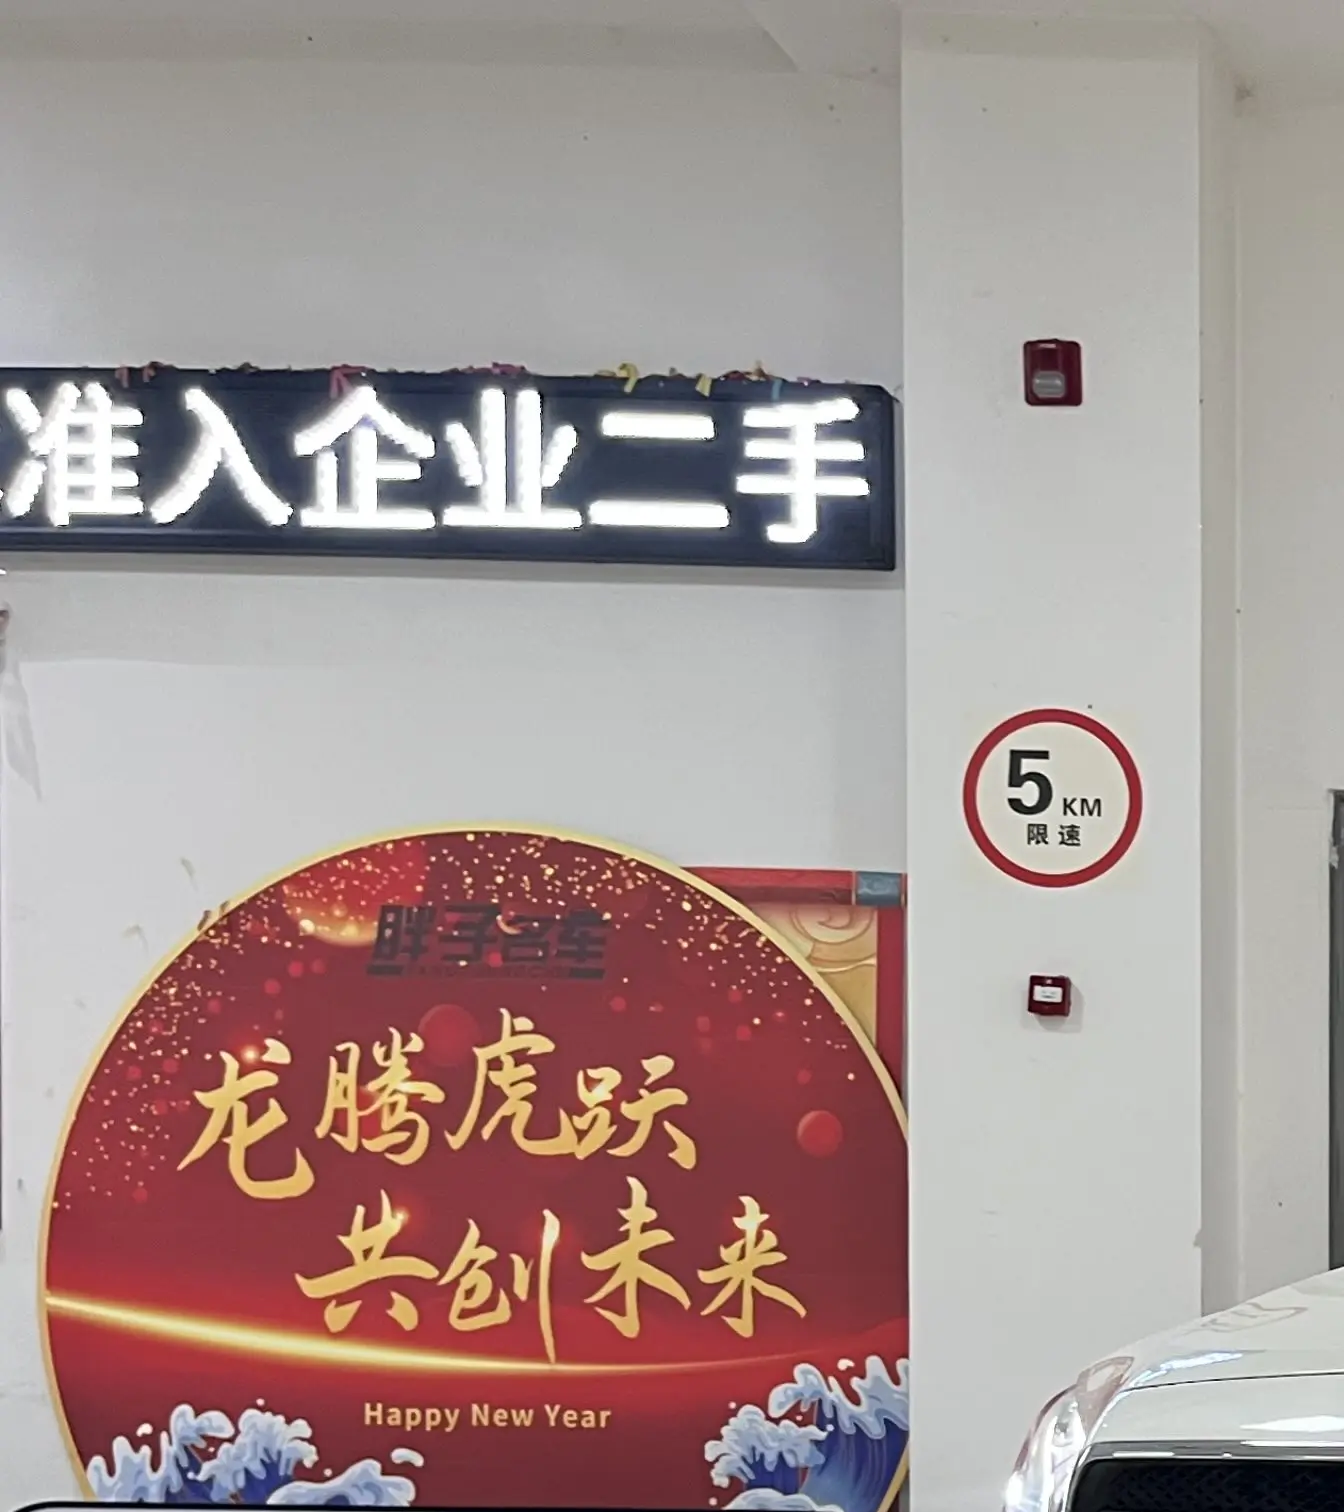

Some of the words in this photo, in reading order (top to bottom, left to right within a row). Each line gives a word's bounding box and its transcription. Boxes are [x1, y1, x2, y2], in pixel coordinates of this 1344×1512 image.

[6, 380, 871, 545] 准入企业二手
[1007, 748, 1054, 816] 5
[1062, 797, 1103, 818] KM
[1026, 822, 1082, 847] 限速
[177, 1007, 699, 1200] 龙腾虎跃
[294, 1176, 808, 1366] 共创未来
[364, 1402, 461, 1432] Happy
[471, 1403, 534, 1427] New
[544, 1403, 612, 1429] Year
